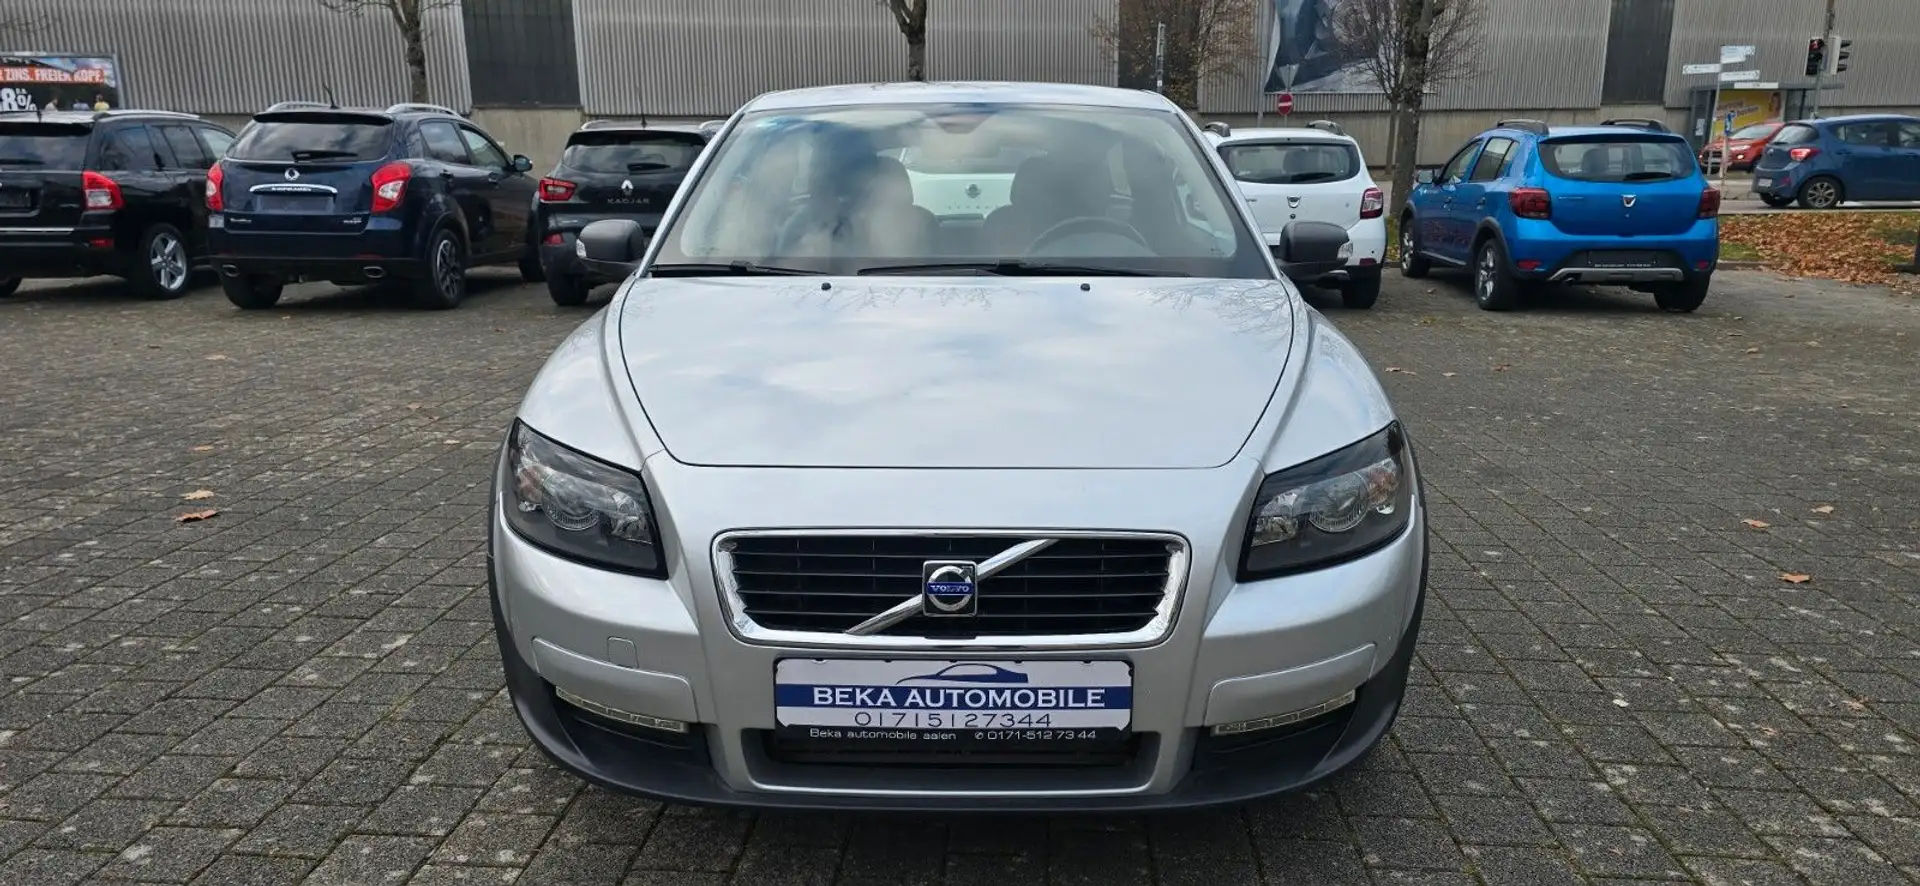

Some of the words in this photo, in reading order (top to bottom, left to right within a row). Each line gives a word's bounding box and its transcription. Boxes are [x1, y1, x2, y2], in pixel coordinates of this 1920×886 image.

[4, 68, 33, 82] ZINS.
[0, 88, 38, 111] 8%
[930, 584, 970, 592] VOLVO
[813, 687, 897, 706] BEKA
[904, 688, 1105, 708] AUTOMOBILE
[854, 711, 1052, 728] 01715127344
[809, 728, 841, 738] Beka
[847, 729, 917, 740] automobile
[987, 730, 1053, 740] 0171-512
[1056, 730, 1074, 740] 73
[1078, 730, 1096, 740] 44
